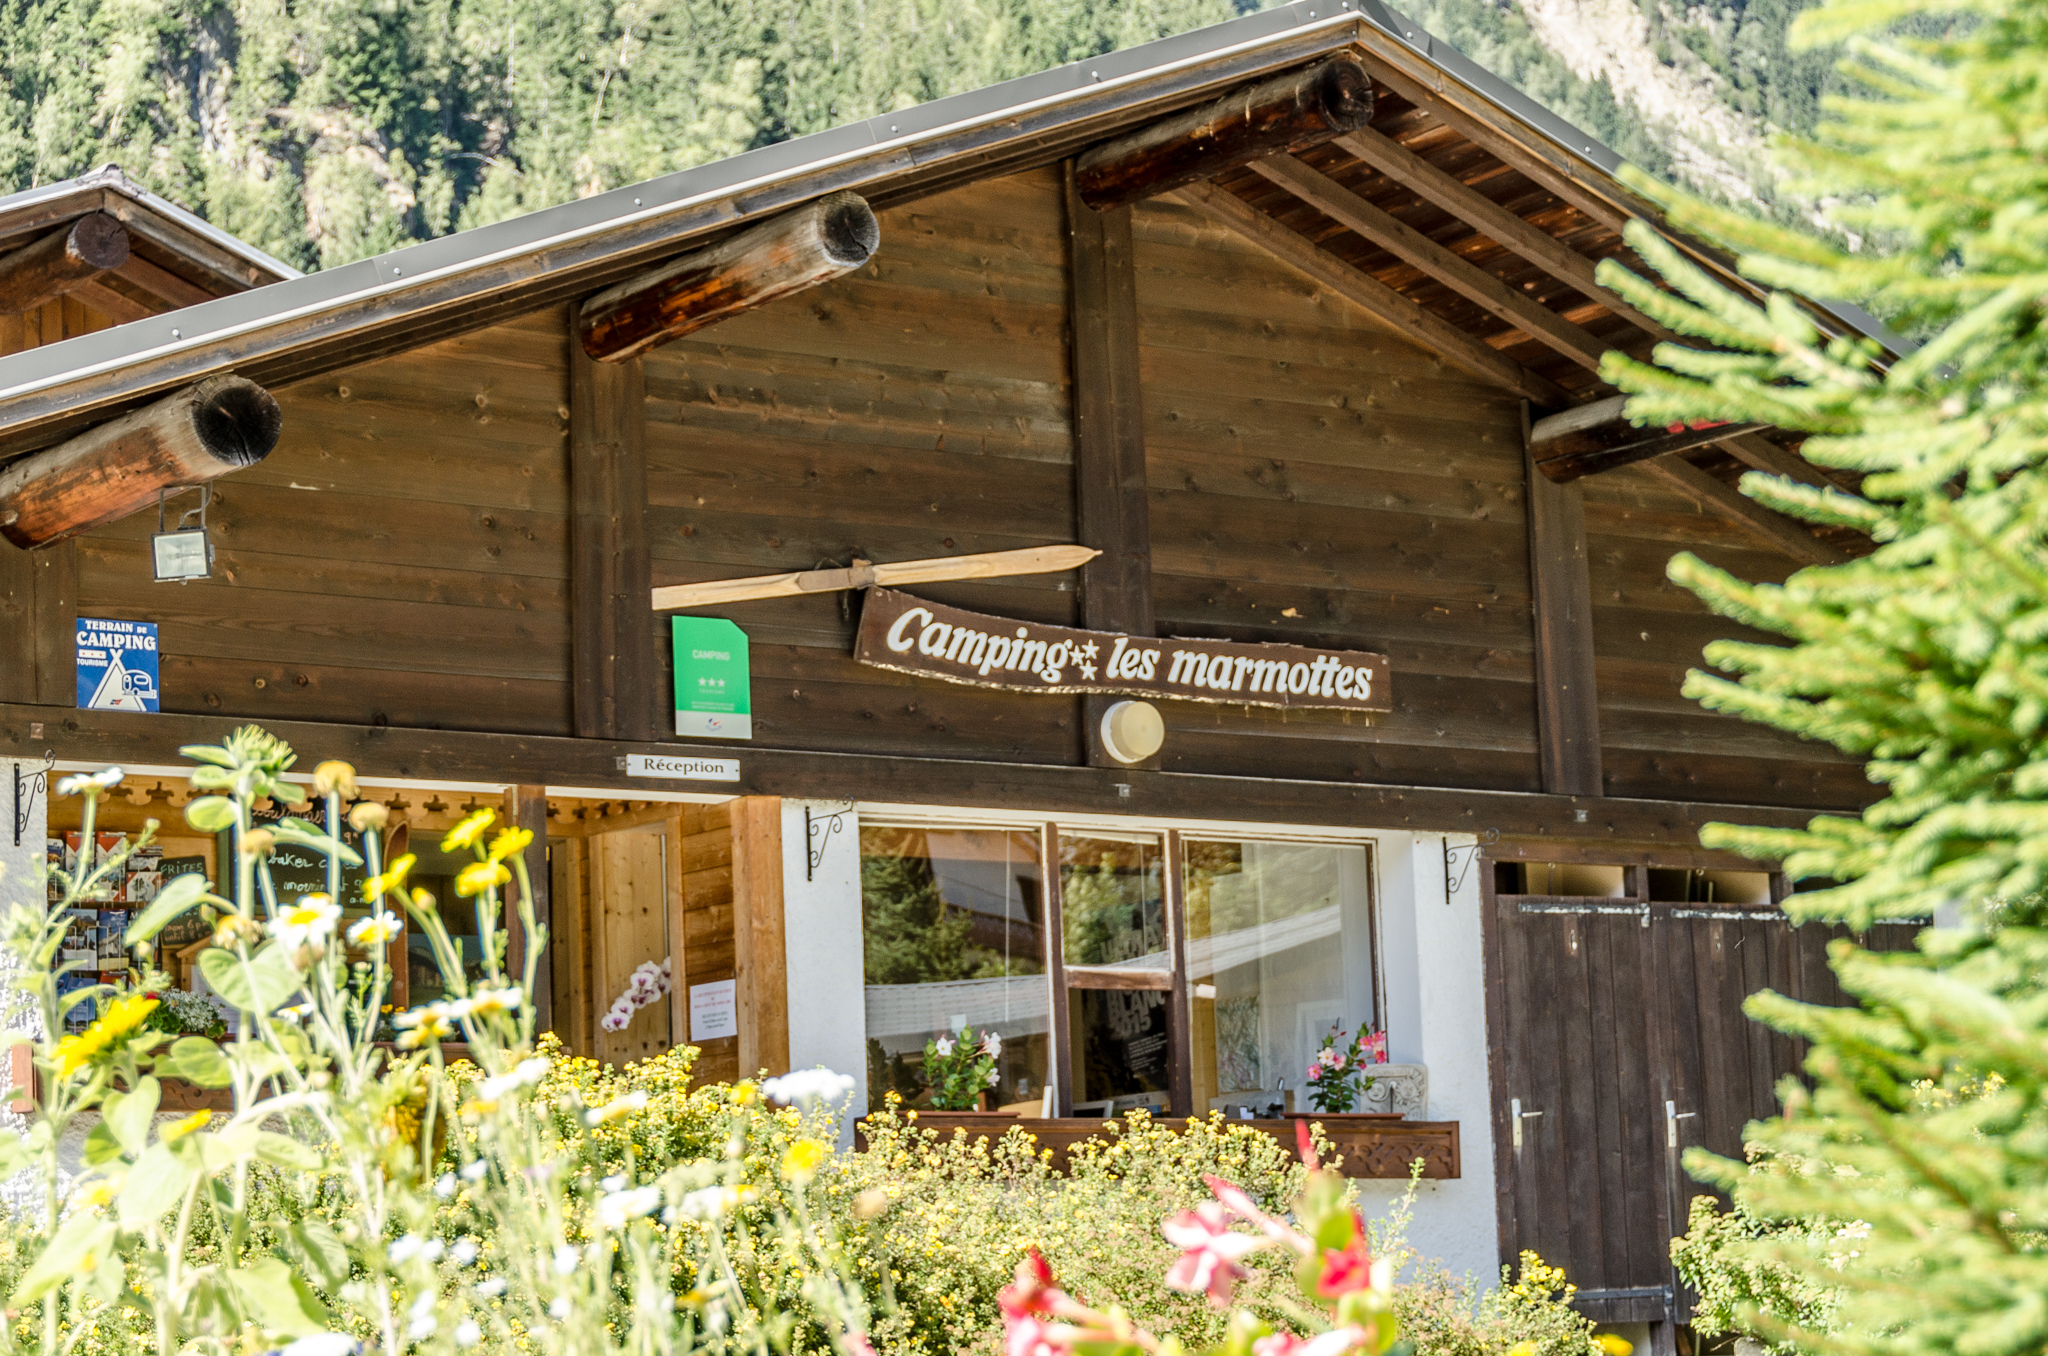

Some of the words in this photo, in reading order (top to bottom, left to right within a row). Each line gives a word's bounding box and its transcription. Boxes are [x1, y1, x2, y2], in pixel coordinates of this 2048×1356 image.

[85, 619, 134, 633] TERRAIN
[136, 626, 148, 634] DE
[76, 631, 156, 651] CAMPING
[691, 649, 731, 662] CAMPING
[886, 606, 1072, 683] Camping
[1105, 637, 1161, 680] les
[1167, 648, 1374, 701] marmottes
[76, 658, 109, 667] TOURISME
[643, 757, 725, 775] Réception
